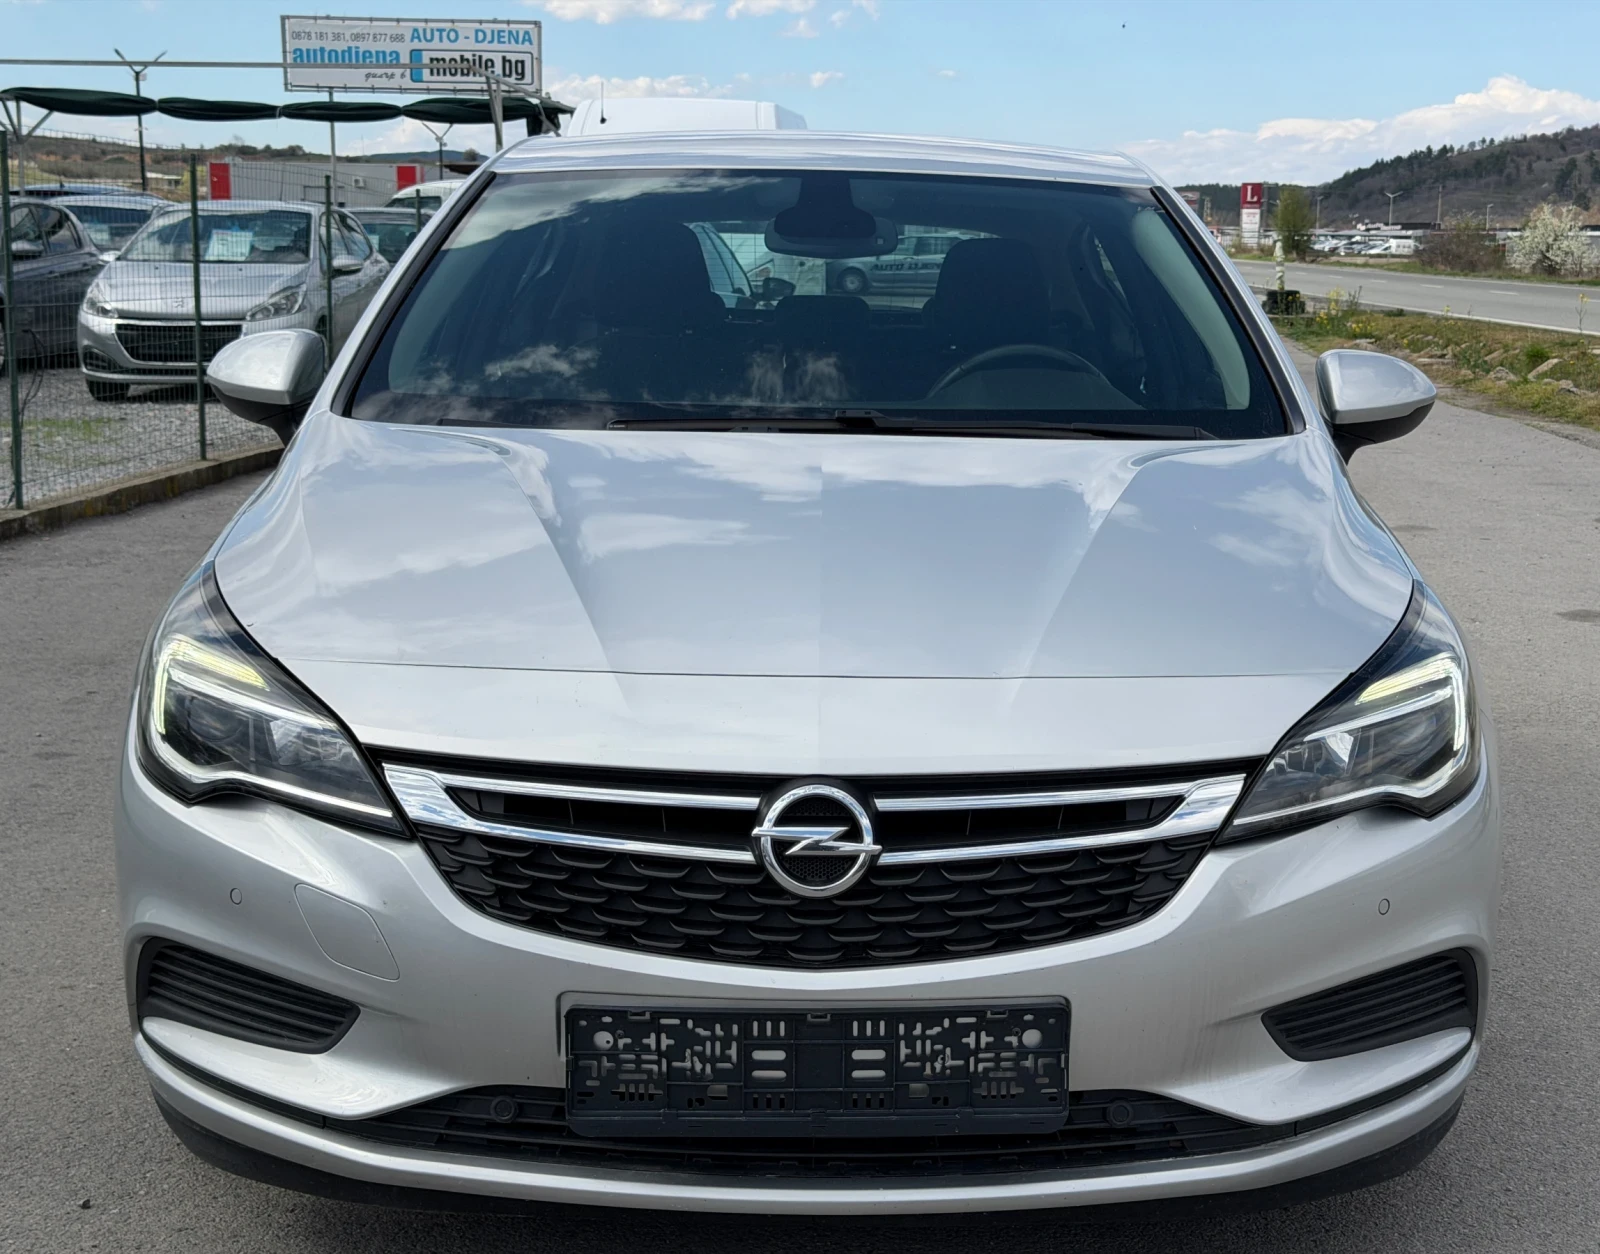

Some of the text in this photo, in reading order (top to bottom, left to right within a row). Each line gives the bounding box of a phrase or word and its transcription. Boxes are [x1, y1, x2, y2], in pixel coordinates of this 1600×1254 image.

[291, 30, 312, 41] 0878
[314, 31, 329, 41] 181
[350, 32, 371, 43] 0897
[372, 32, 388, 43] 877
[389, 33, 406, 43] 688
[410, 27, 460, 43] AUTO
[474, 28, 534, 46] DJENA
[429, 53, 526, 81] mobile.bg
[1246, 185, 1258, 202] L
[870, 262, 905, 272] AUTO
